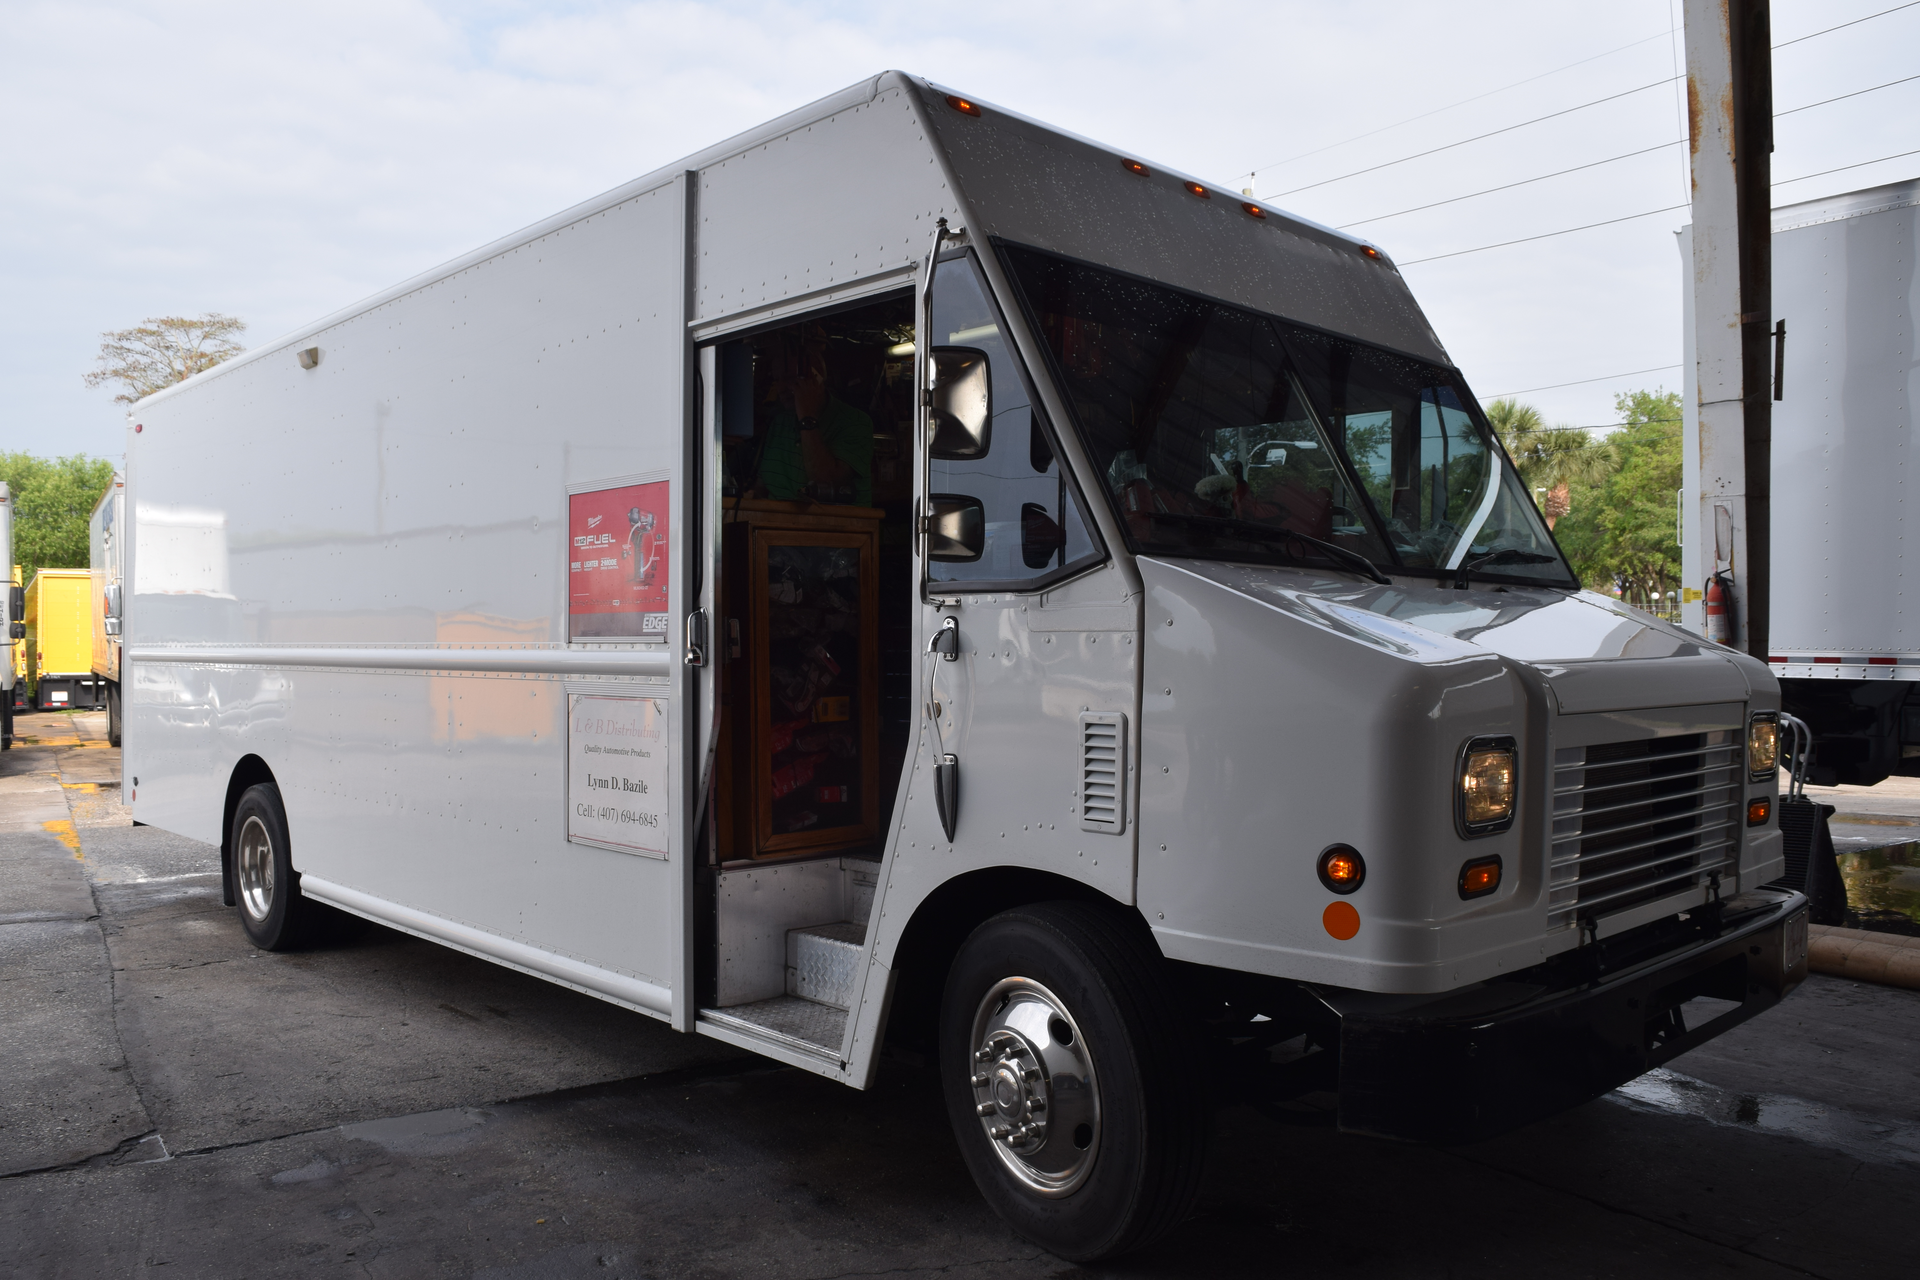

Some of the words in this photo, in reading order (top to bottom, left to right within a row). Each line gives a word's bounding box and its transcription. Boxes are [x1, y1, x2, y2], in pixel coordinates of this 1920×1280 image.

[587, 534, 616, 545] FUEL
[643, 617, 668, 630] EDGE
[575, 718, 582, 733] L
[585, 719, 593, 734] &
[595, 719, 604, 734] B
[606, 719, 660, 742] Distributing
[584, 744, 603, 756] Quality
[602, 746, 630, 757] Automotive
[630, 748, 651, 759] Products
[587, 773, 609, 791] Lynn
[611, 776, 621, 791] D.
[623, 778, 648, 794] Bazile
[577, 803, 595, 818] Cell:
[597, 806, 619, 825] (407)
[621, 810, 658, 828] 694-6845
